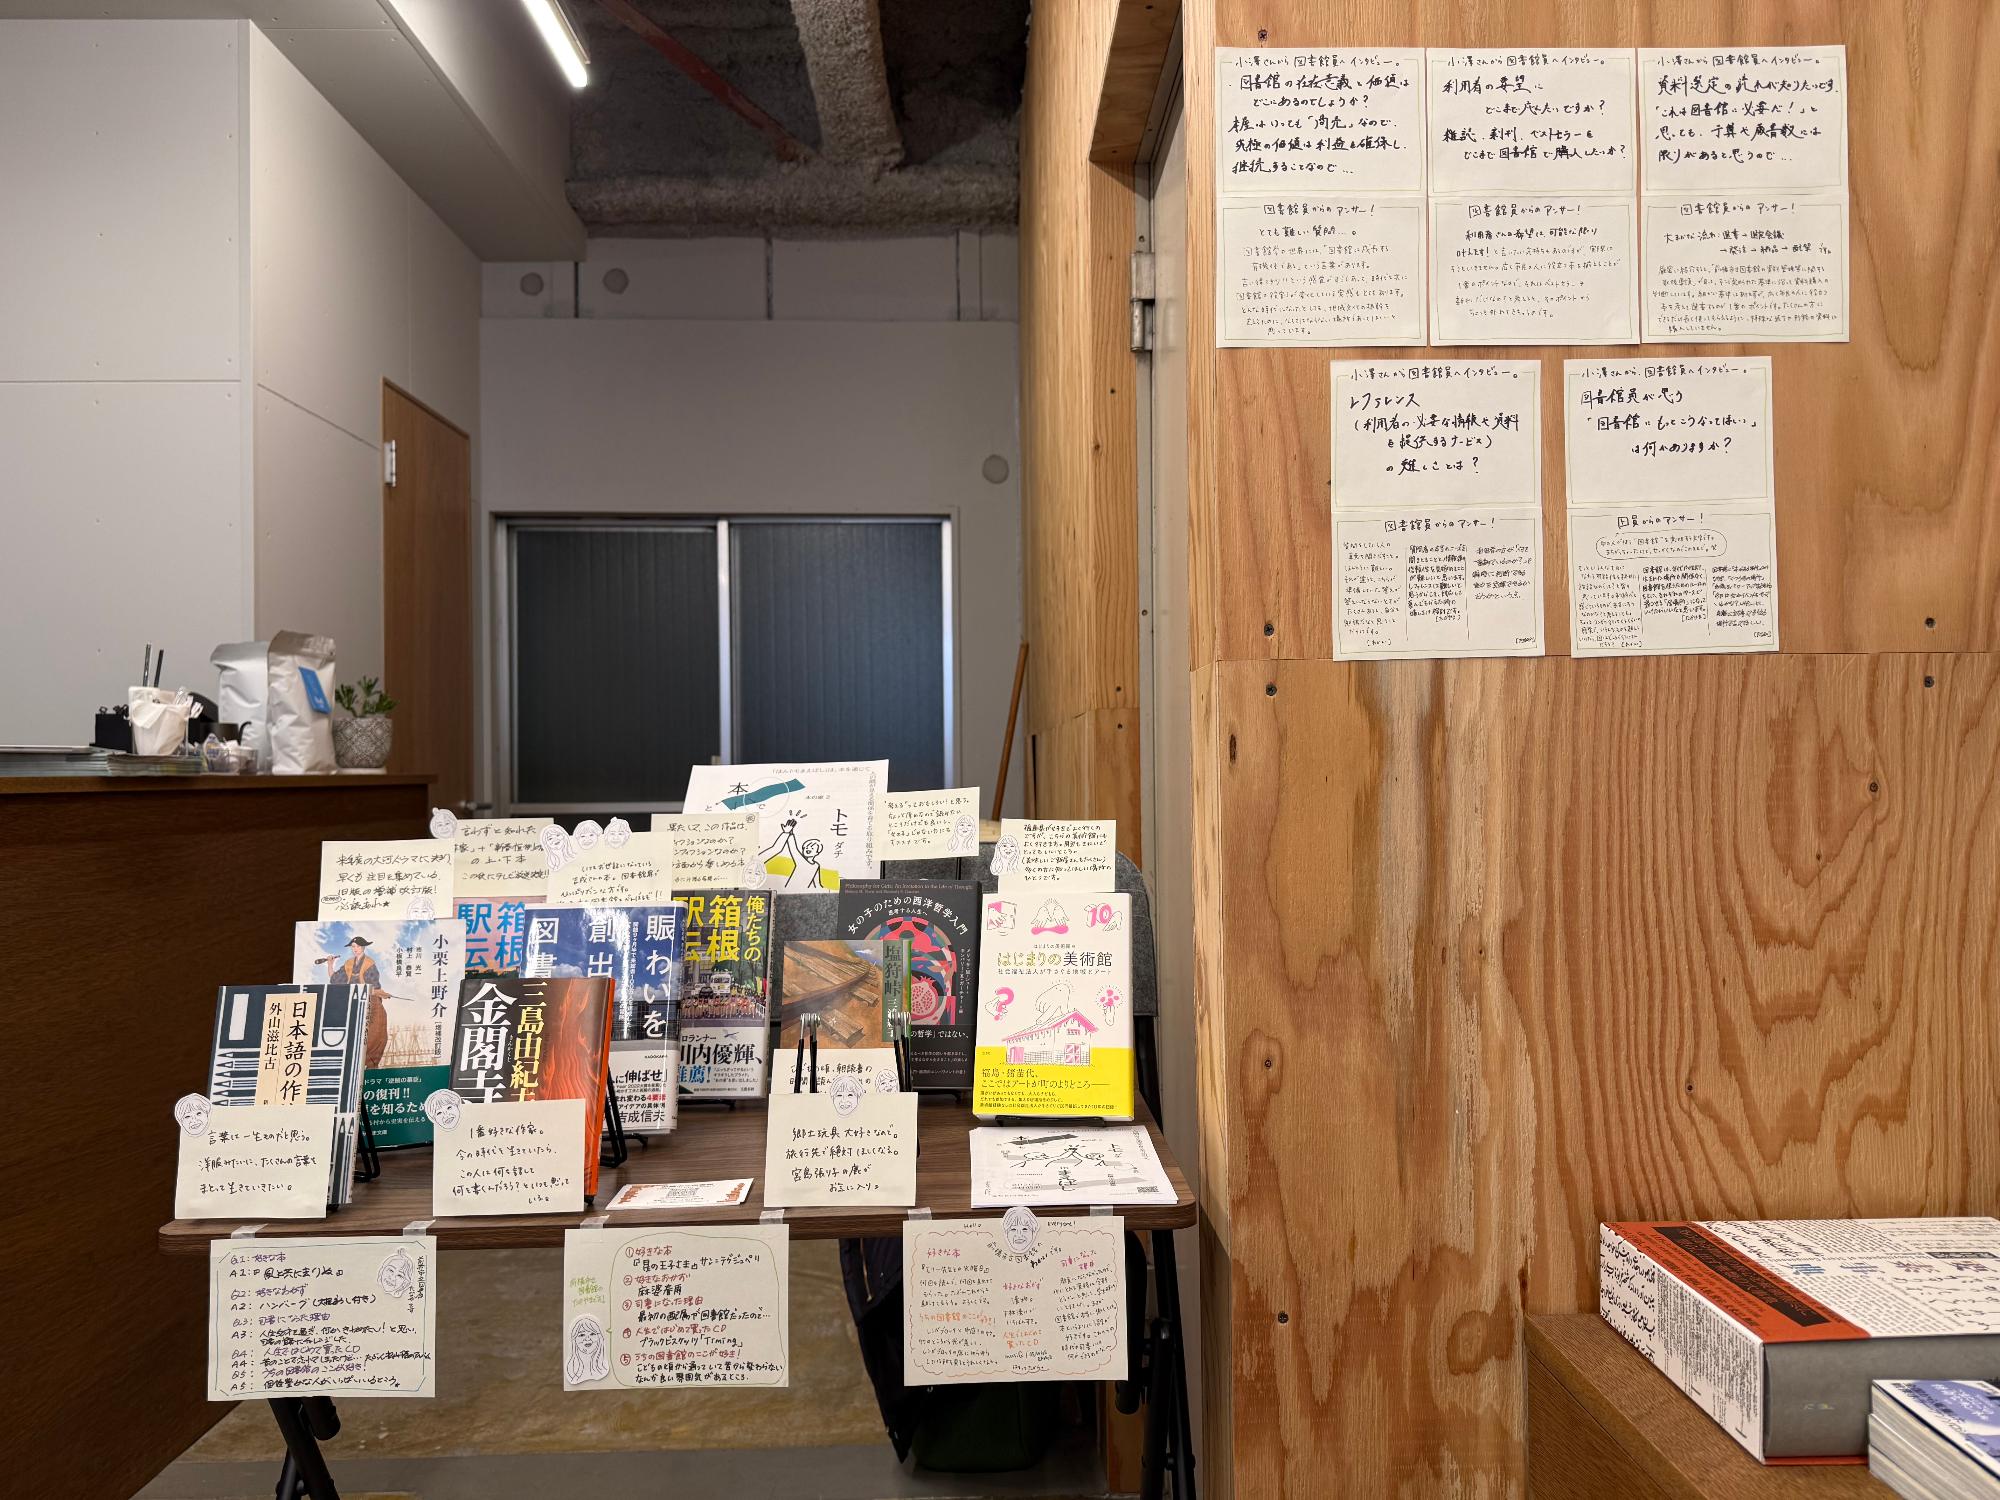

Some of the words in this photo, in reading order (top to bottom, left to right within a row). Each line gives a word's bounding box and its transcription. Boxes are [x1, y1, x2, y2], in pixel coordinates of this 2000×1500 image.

[1442, 74, 1544, 95] 利用者の要望に
[1349, 392, 1421, 410] レファレンス
[1581, 387, 1683, 409] 図書館員が思う
[1384, 517, 1495, 532] 図書館員からのアンサー！
[848, 895, 969, 936] 女の子のための西洋哲学入門
[494, 901, 526, 968] 箱根
[706, 894, 743, 962] 箱根
[744, 895, 765, 962] 俺たちの
[997, 951, 1113, 967] はじまりの美術館
[431, 934, 449, 1018] 小栗上野介
[642, 914, 676, 1039] 賑わいを
[884, 944, 902, 997] 塩狩峠
[264, 1002, 282, 1070] 外山滋比古
[280, 1001, 308, 1105] 日本語の作
[619, 1110, 665, 1123] 吉成信夫
[208, 1128, 310, 1145] 言葉は一生ものだと思う。
[470, 1121, 544, 1139] 1番好きな作家。
[785, 1144, 899, 1160] 旅行先で絶対ほしくなる。
[199, 1155, 317, 1172] 洋服みたいに、たくさんの言葉を
[460, 1166, 535, 1179] この人は何を話して
[791, 1163, 872, 1182] 宮島張り子の鹿が
[200, 1182, 292, 1195] まとって生きていきたい。
[926, 1248, 961, 1259] 好きな本
